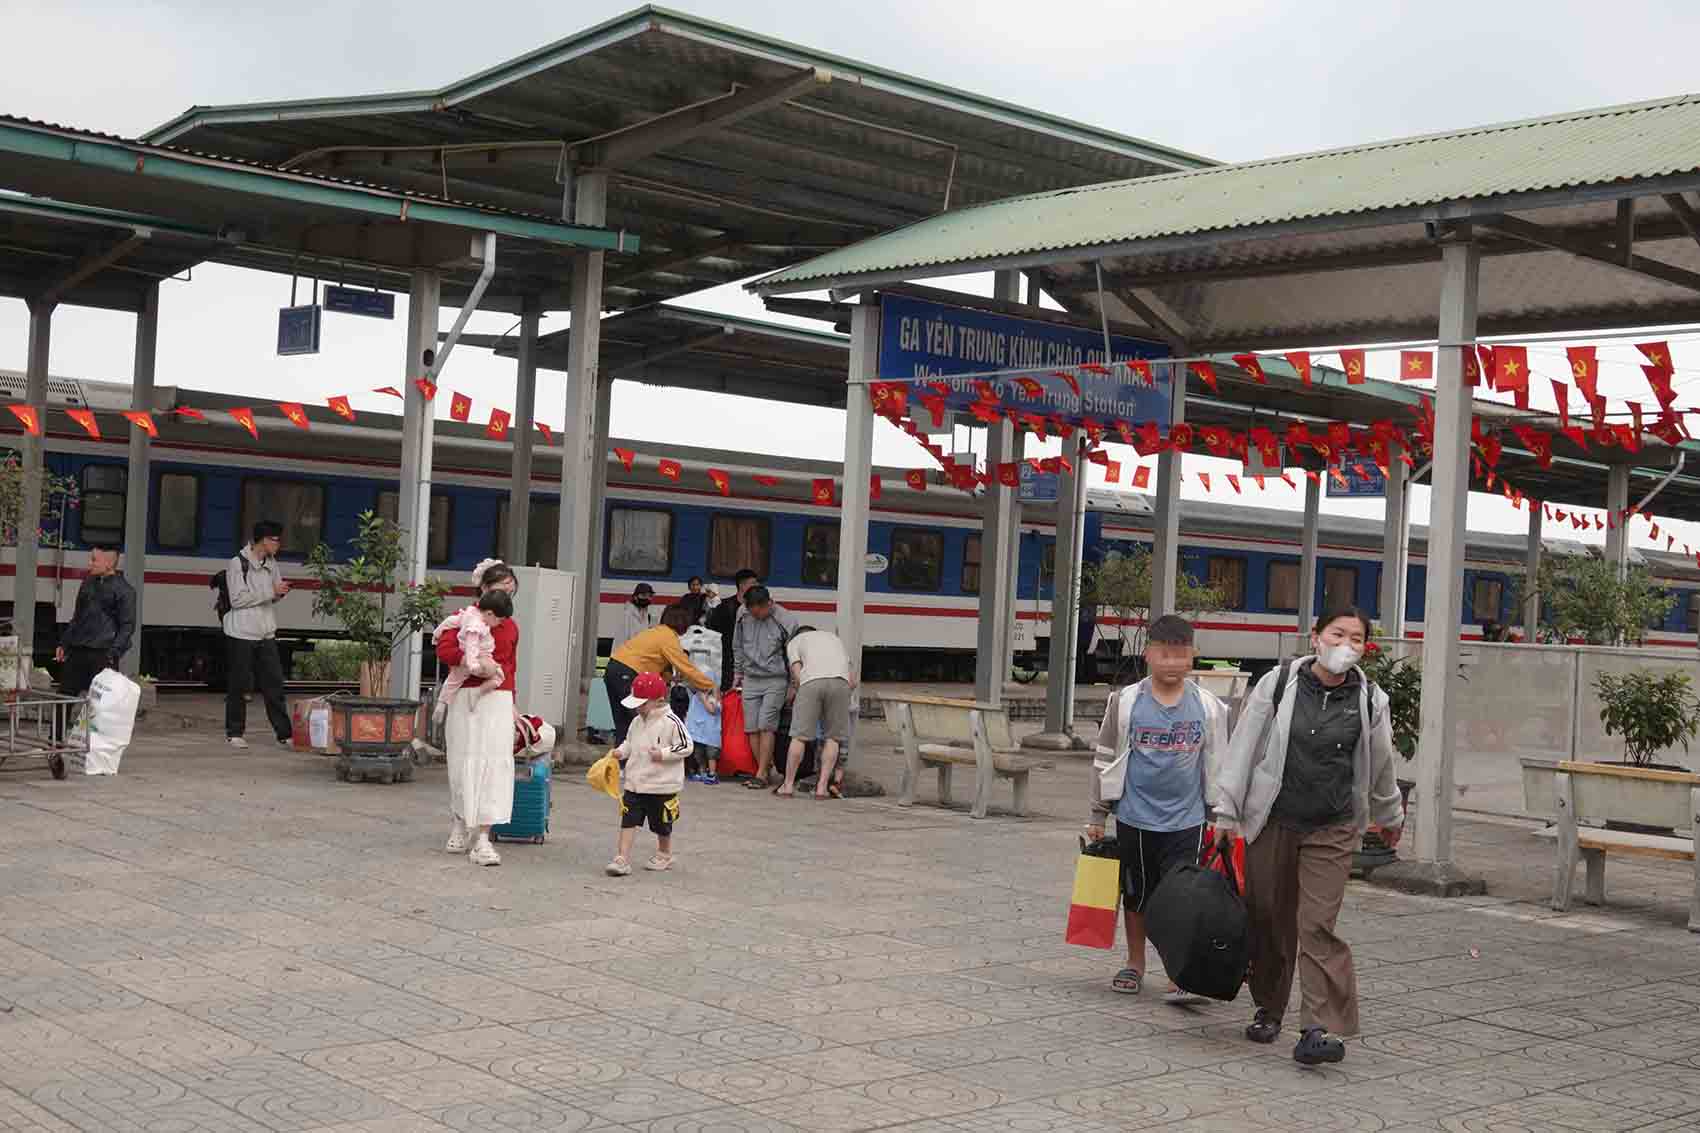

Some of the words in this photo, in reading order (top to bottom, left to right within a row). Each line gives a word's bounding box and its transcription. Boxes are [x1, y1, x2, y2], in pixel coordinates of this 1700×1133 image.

[899, 316, 921, 352] GA
[925, 313, 955, 358] YÊN
[959, 326, 1006, 365] TRUNG
[1008, 328, 1043, 369] KÍNH
[1041, 384, 1080, 414] Trung
[1085, 390, 1137, 418] Station
